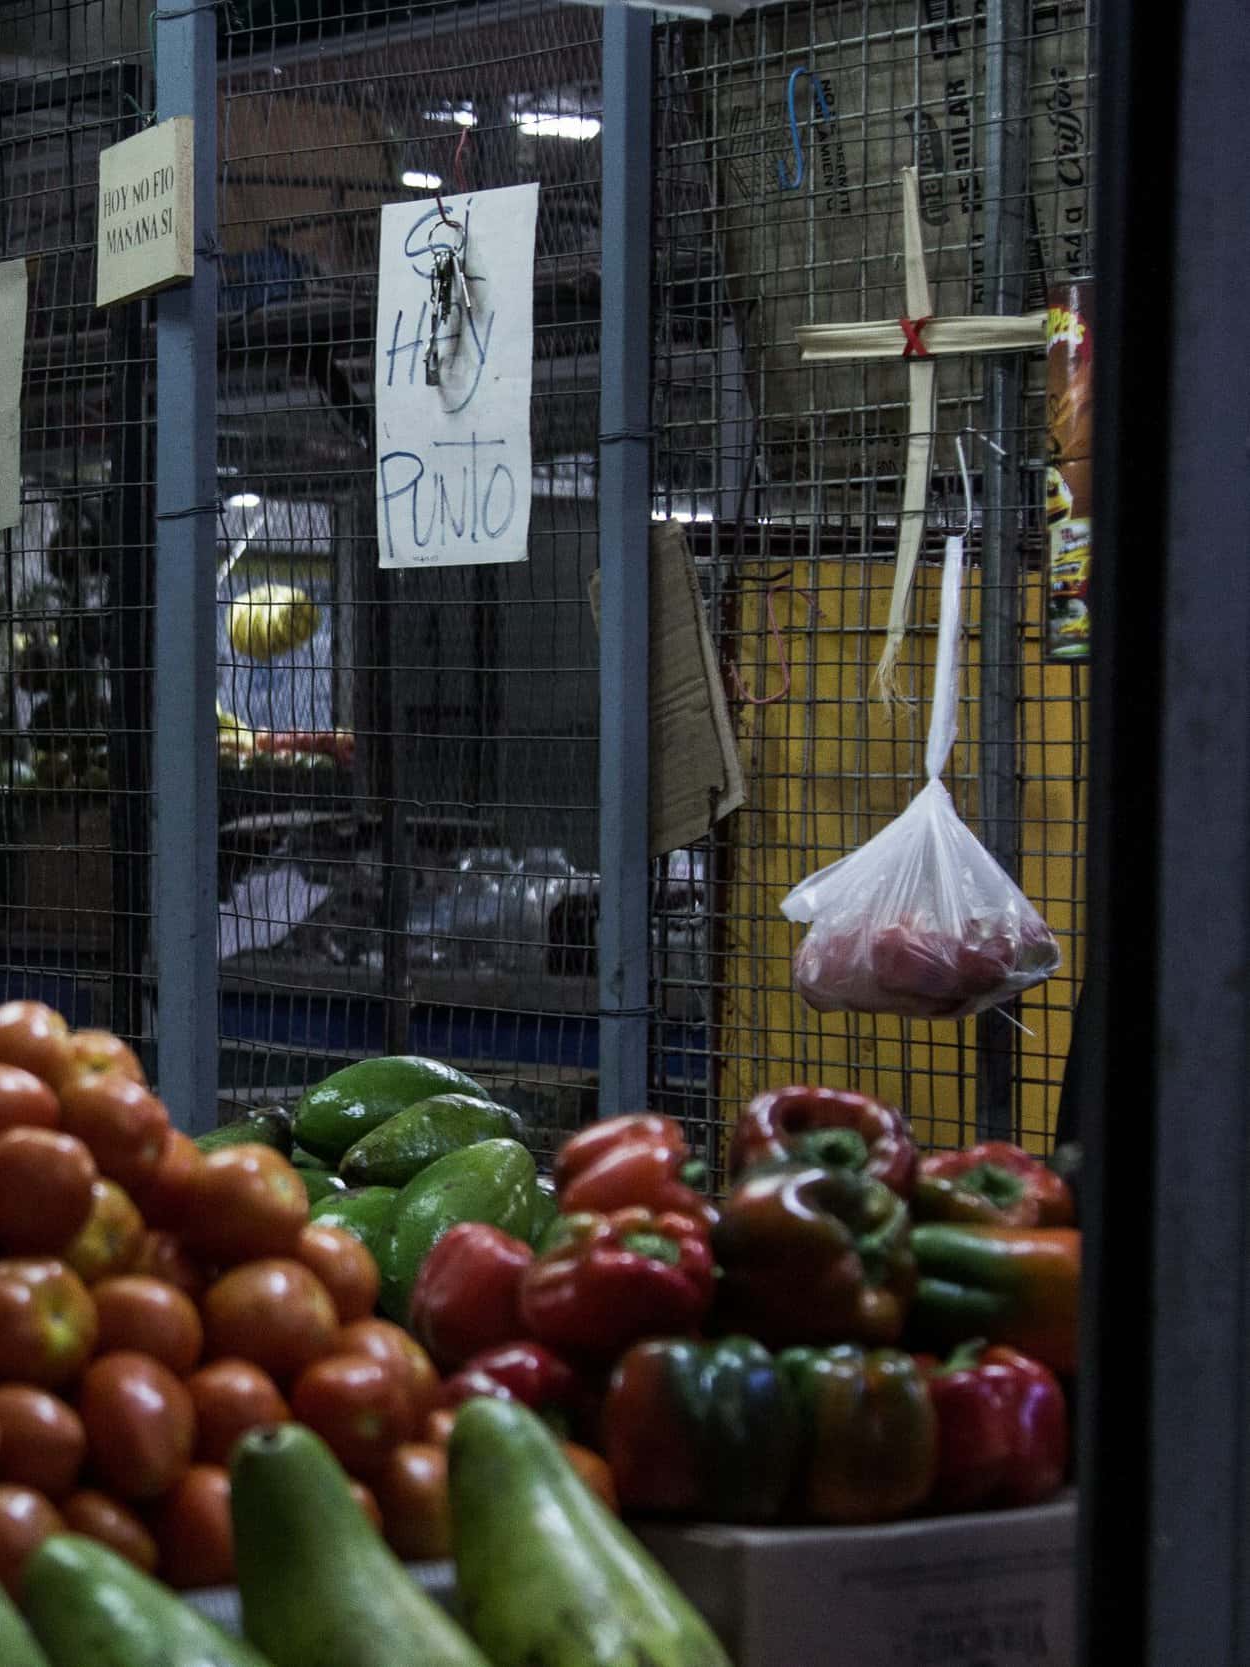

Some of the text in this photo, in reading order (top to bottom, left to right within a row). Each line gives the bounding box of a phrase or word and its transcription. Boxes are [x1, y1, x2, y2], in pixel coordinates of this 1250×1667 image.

[103, 166, 175, 219] HOY NO FIO
[106, 207, 174, 257] MAÑANA SI
[380, 431, 516, 557] PUNTO
